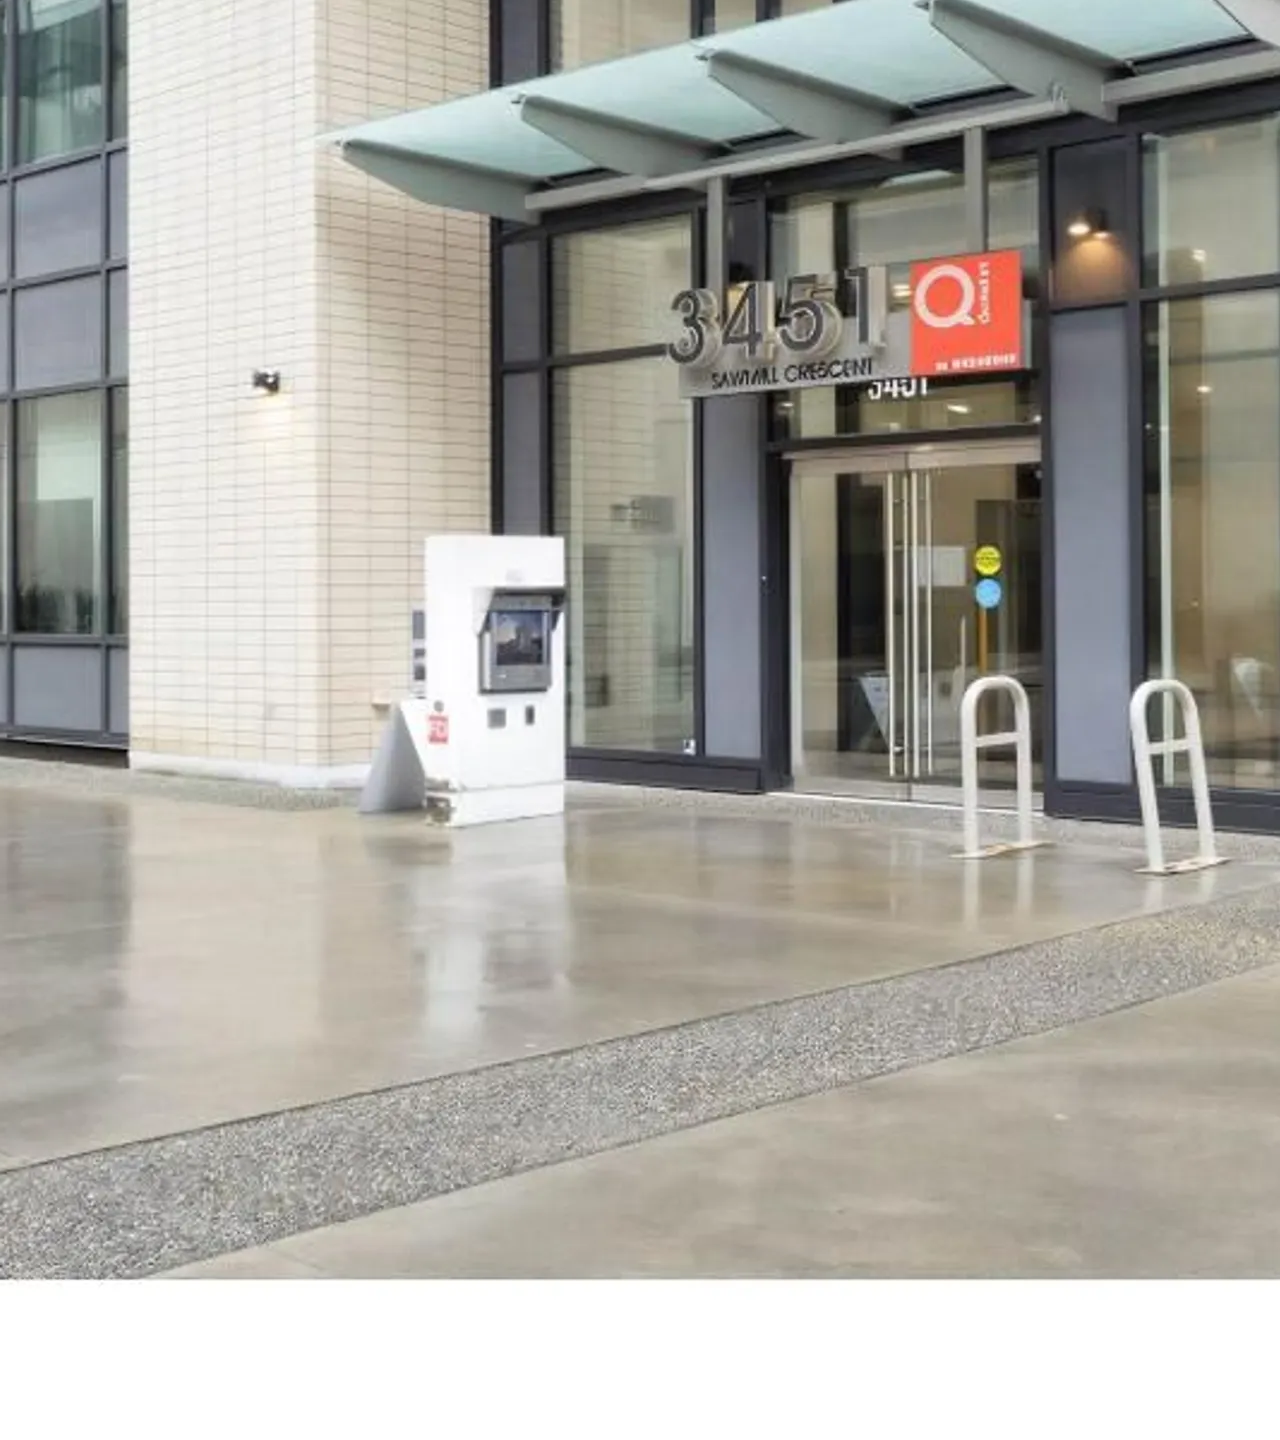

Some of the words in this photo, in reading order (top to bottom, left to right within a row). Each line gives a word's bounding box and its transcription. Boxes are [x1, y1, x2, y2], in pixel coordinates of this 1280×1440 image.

[669, 266, 887, 367] 3451
[914, 264, 975, 328] Q
[711, 367, 780, 390] SAWMILL
[783, 356, 873, 383] CRESCENT
